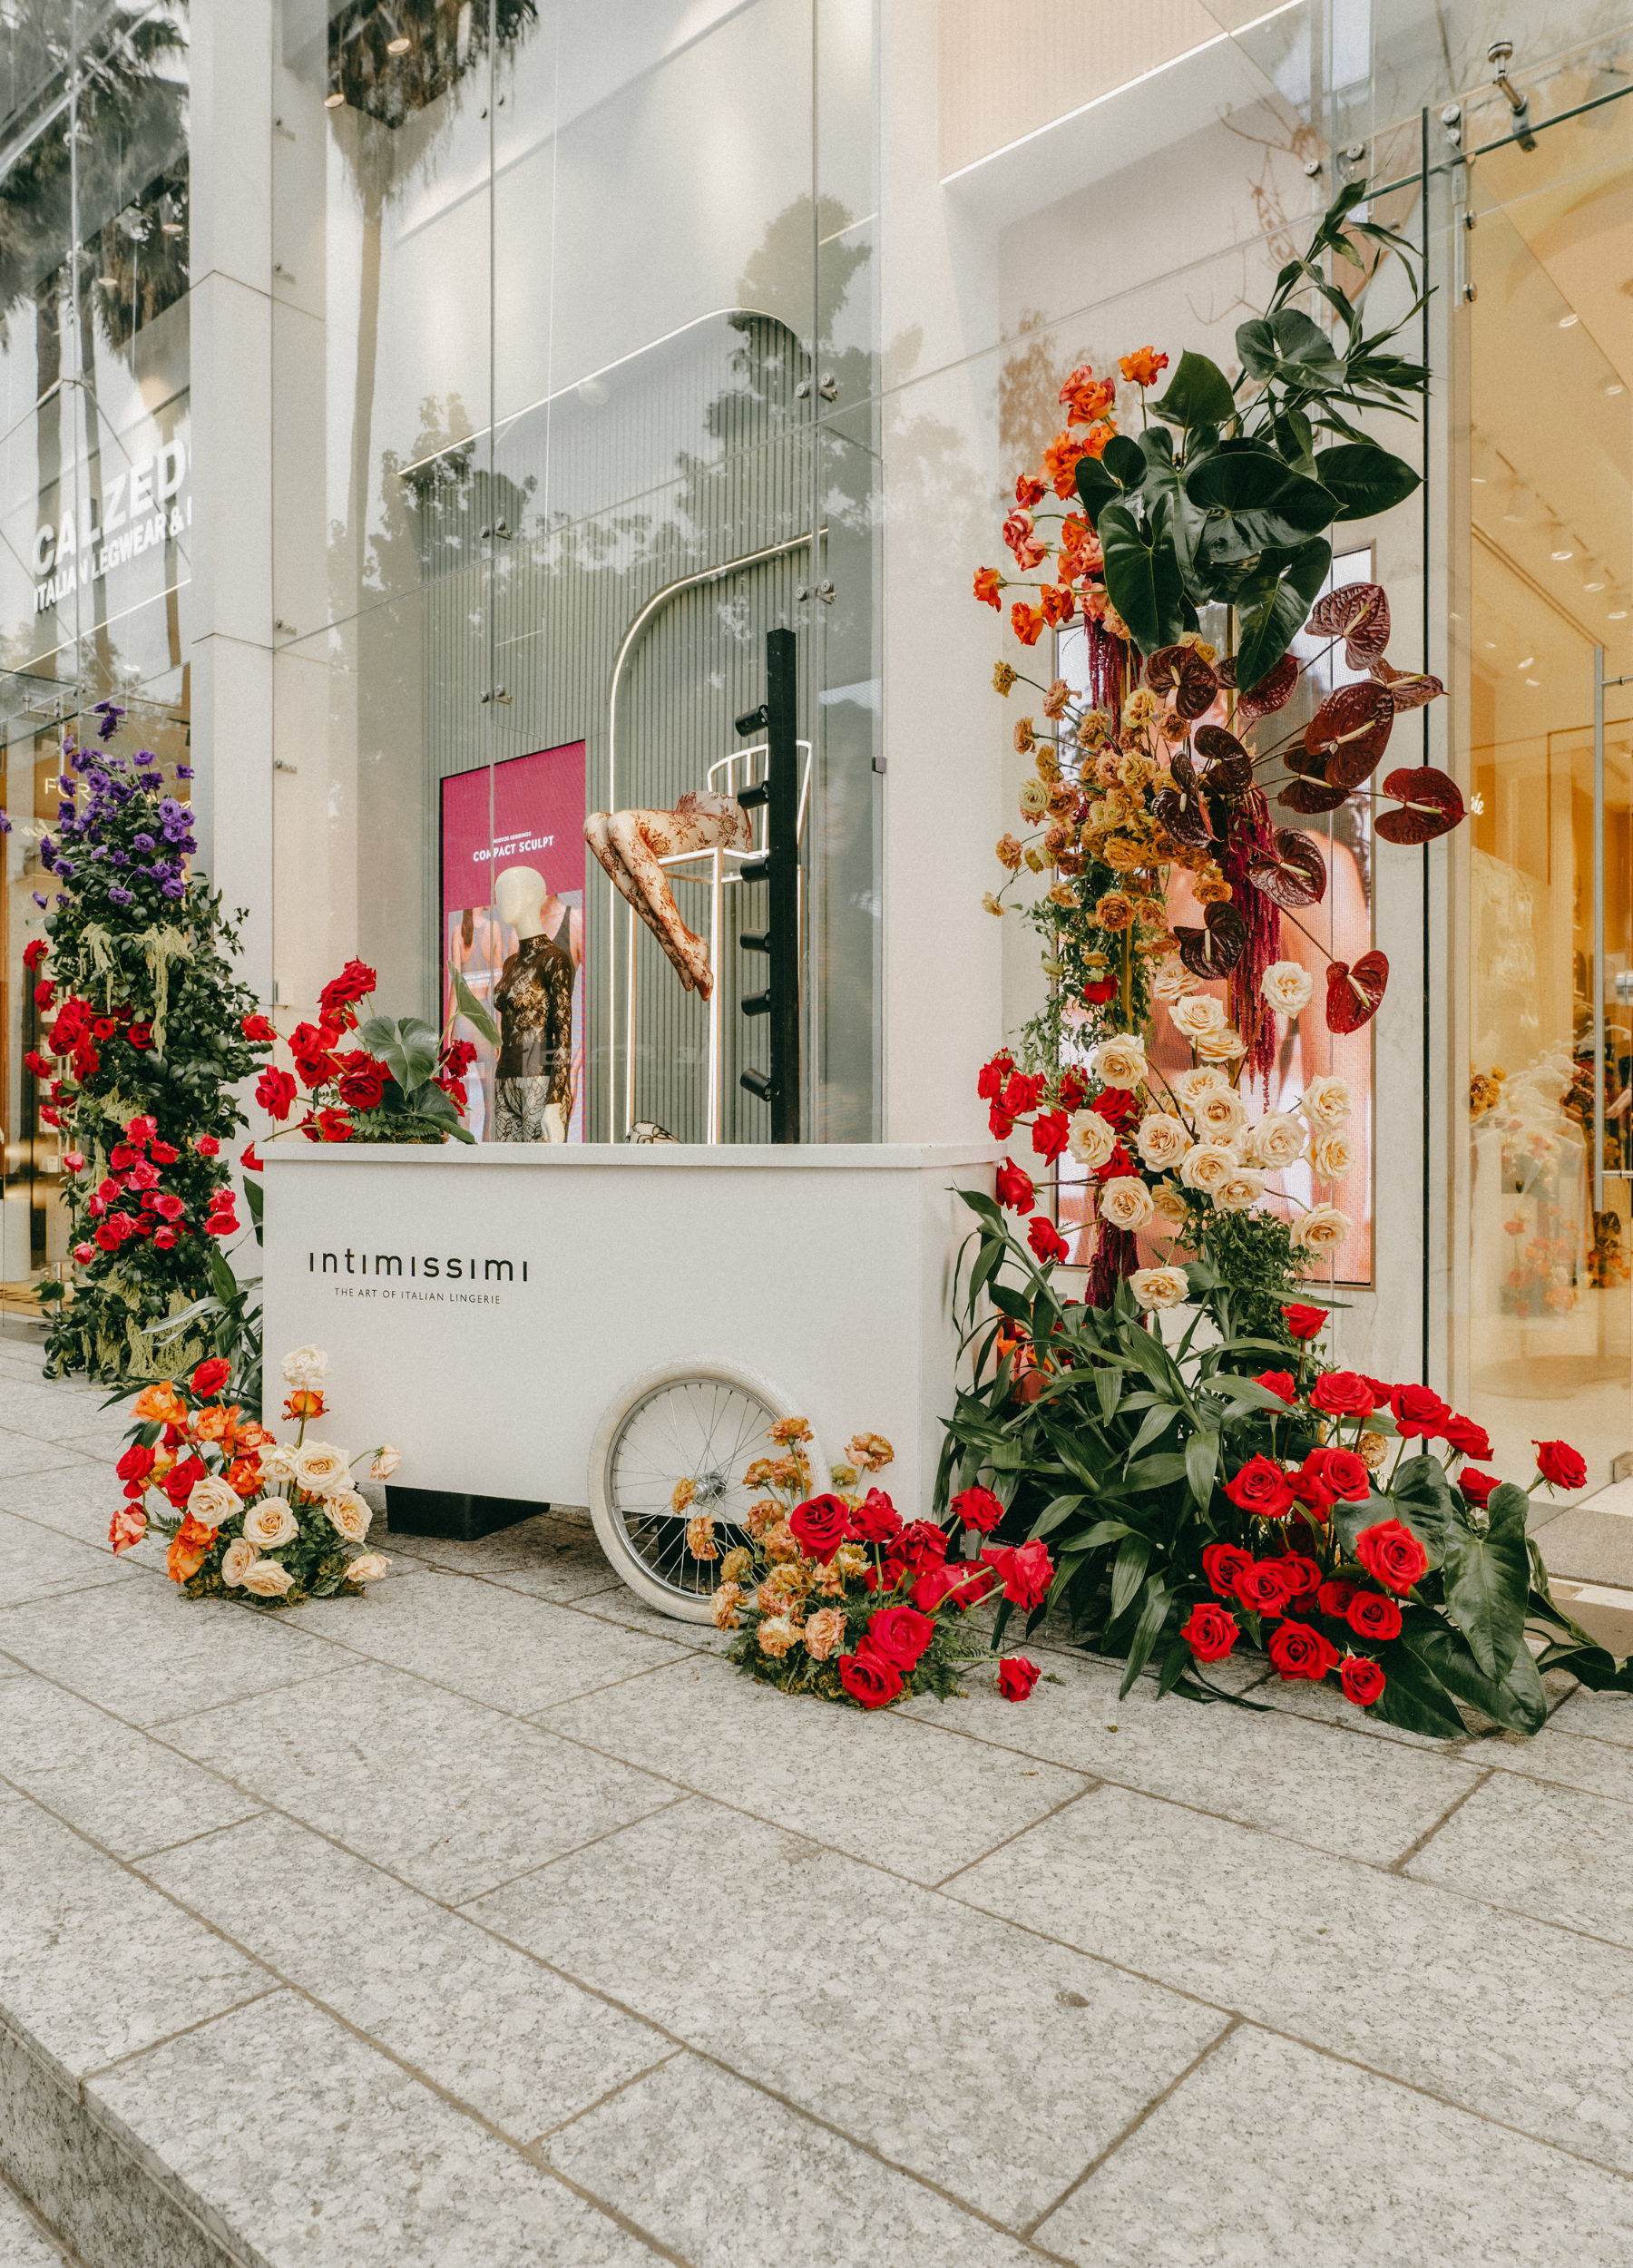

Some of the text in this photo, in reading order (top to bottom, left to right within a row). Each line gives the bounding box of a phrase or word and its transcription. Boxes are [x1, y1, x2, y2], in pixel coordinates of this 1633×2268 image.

[33, 438, 192, 575] CALZED
[34, 558, 88, 613] ITALIAN
[92, 513, 167, 581] LEGWEAR
[170, 506, 184, 536] &
[519, 836, 554, 852] SCULPT
[309, 1248, 528, 1282] intimissimi
[335, 1287, 501, 1305] THE ART OF ITALIAN LINGERIE
